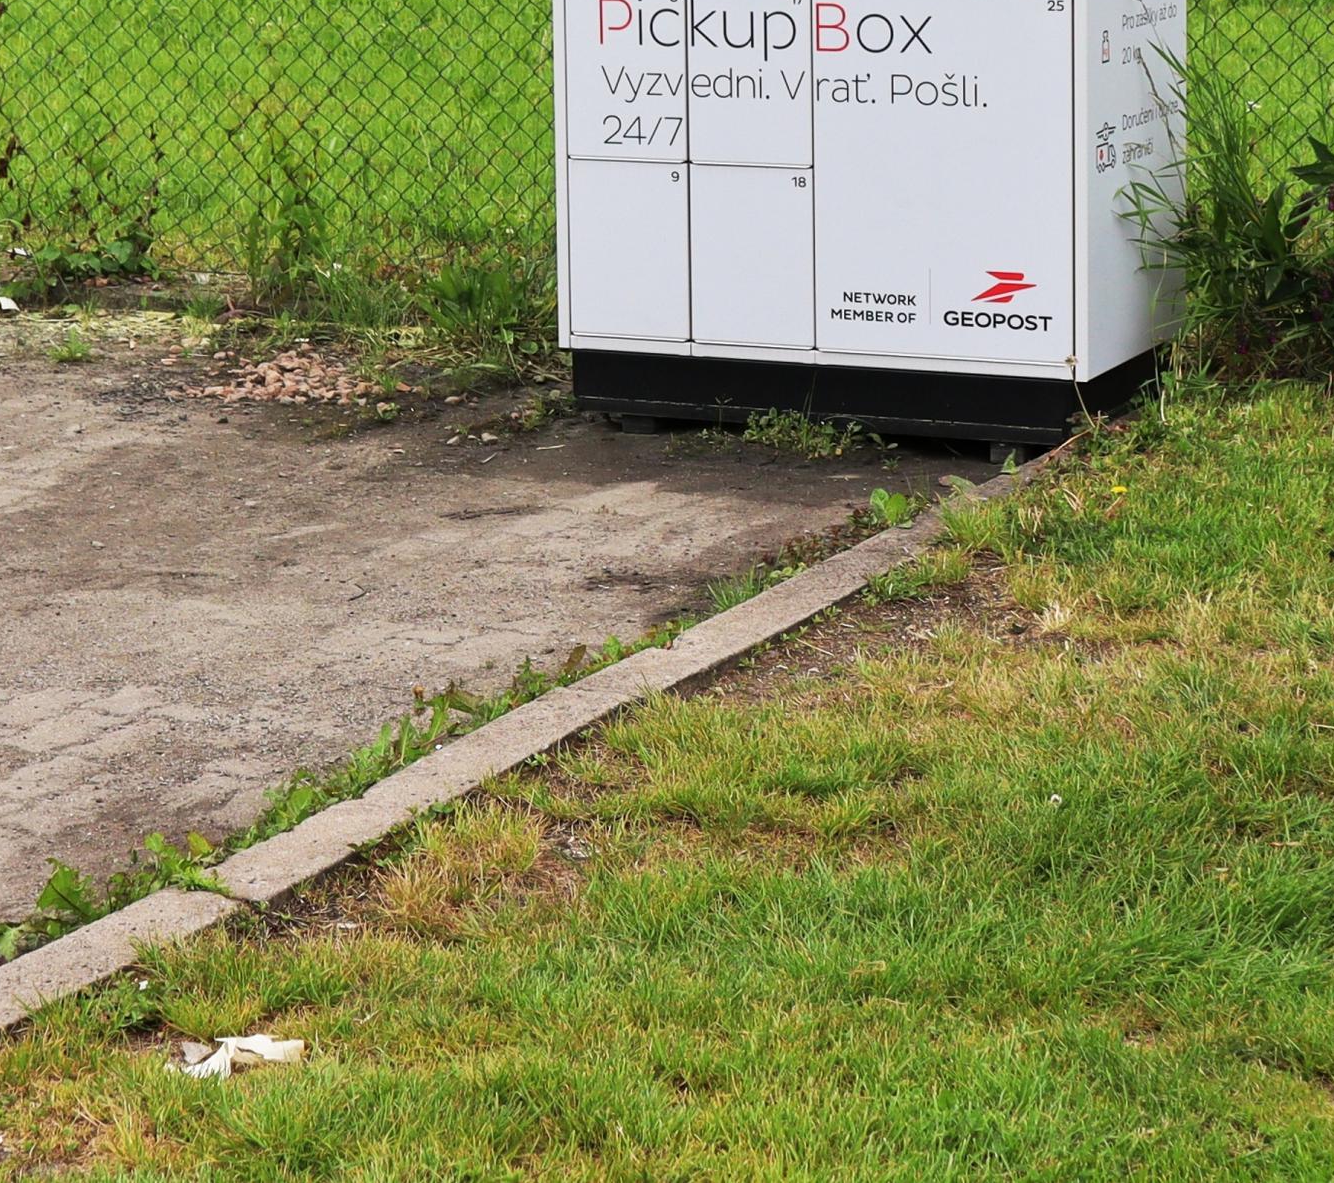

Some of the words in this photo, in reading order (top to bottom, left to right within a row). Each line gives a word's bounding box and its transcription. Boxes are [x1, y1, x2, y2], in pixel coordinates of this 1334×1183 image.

[1046, 0, 1065, 12] 25
[815, 2, 933, 54] Box
[1122, 13, 1135, 30] Pro
[1122, 46, 1131, 65] 20
[601, 64, 770, 103] Vyzvedni.
[780, 69, 876, 105] Vrať.
[891, 73, 988, 108] Pošli.
[603, 114, 683, 146] 24/7
[670, 170, 680, 183] 9
[791, 176, 807, 189] 18
[843, 291, 917, 307] NETWORK
[830, 308, 894, 323] MEMBER
[897, 312, 917, 324] OF
[943, 310, 1053, 332] GEOPOST
